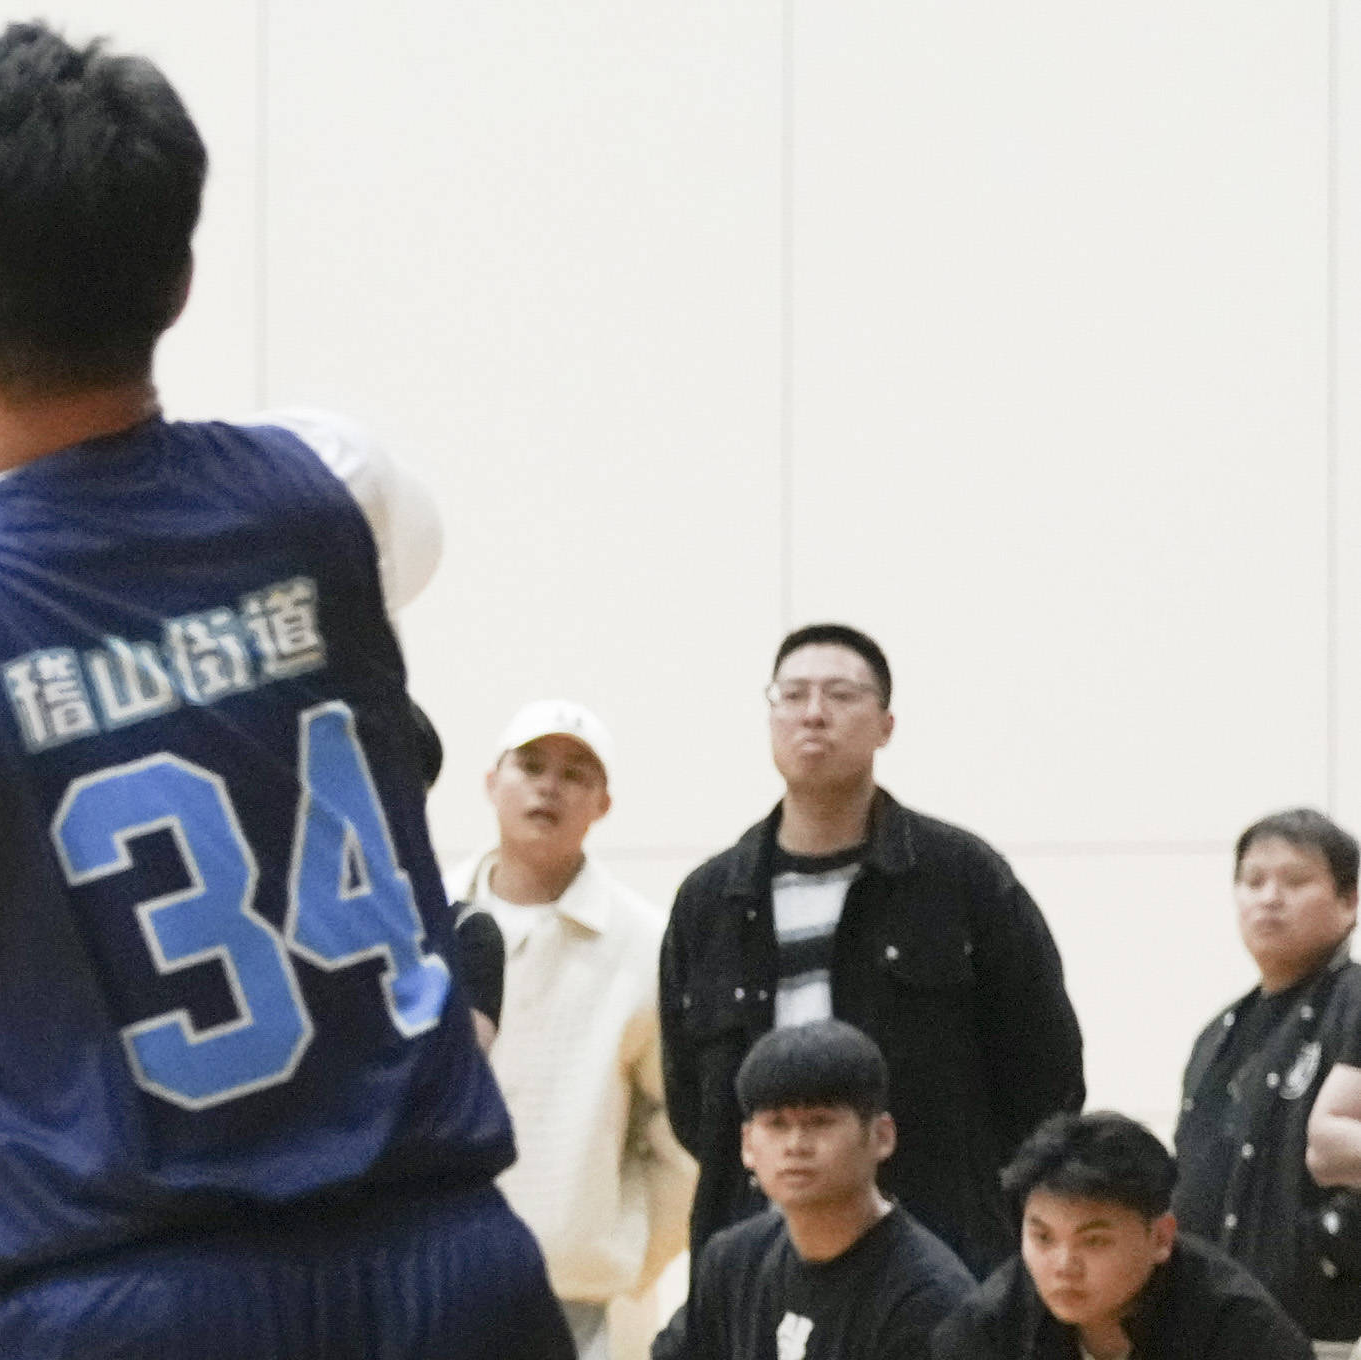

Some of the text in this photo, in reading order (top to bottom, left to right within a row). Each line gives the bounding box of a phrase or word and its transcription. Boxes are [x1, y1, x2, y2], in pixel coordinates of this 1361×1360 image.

[0, 576, 327, 755] 稽山街道
[50, 700, 451, 1111] 34
